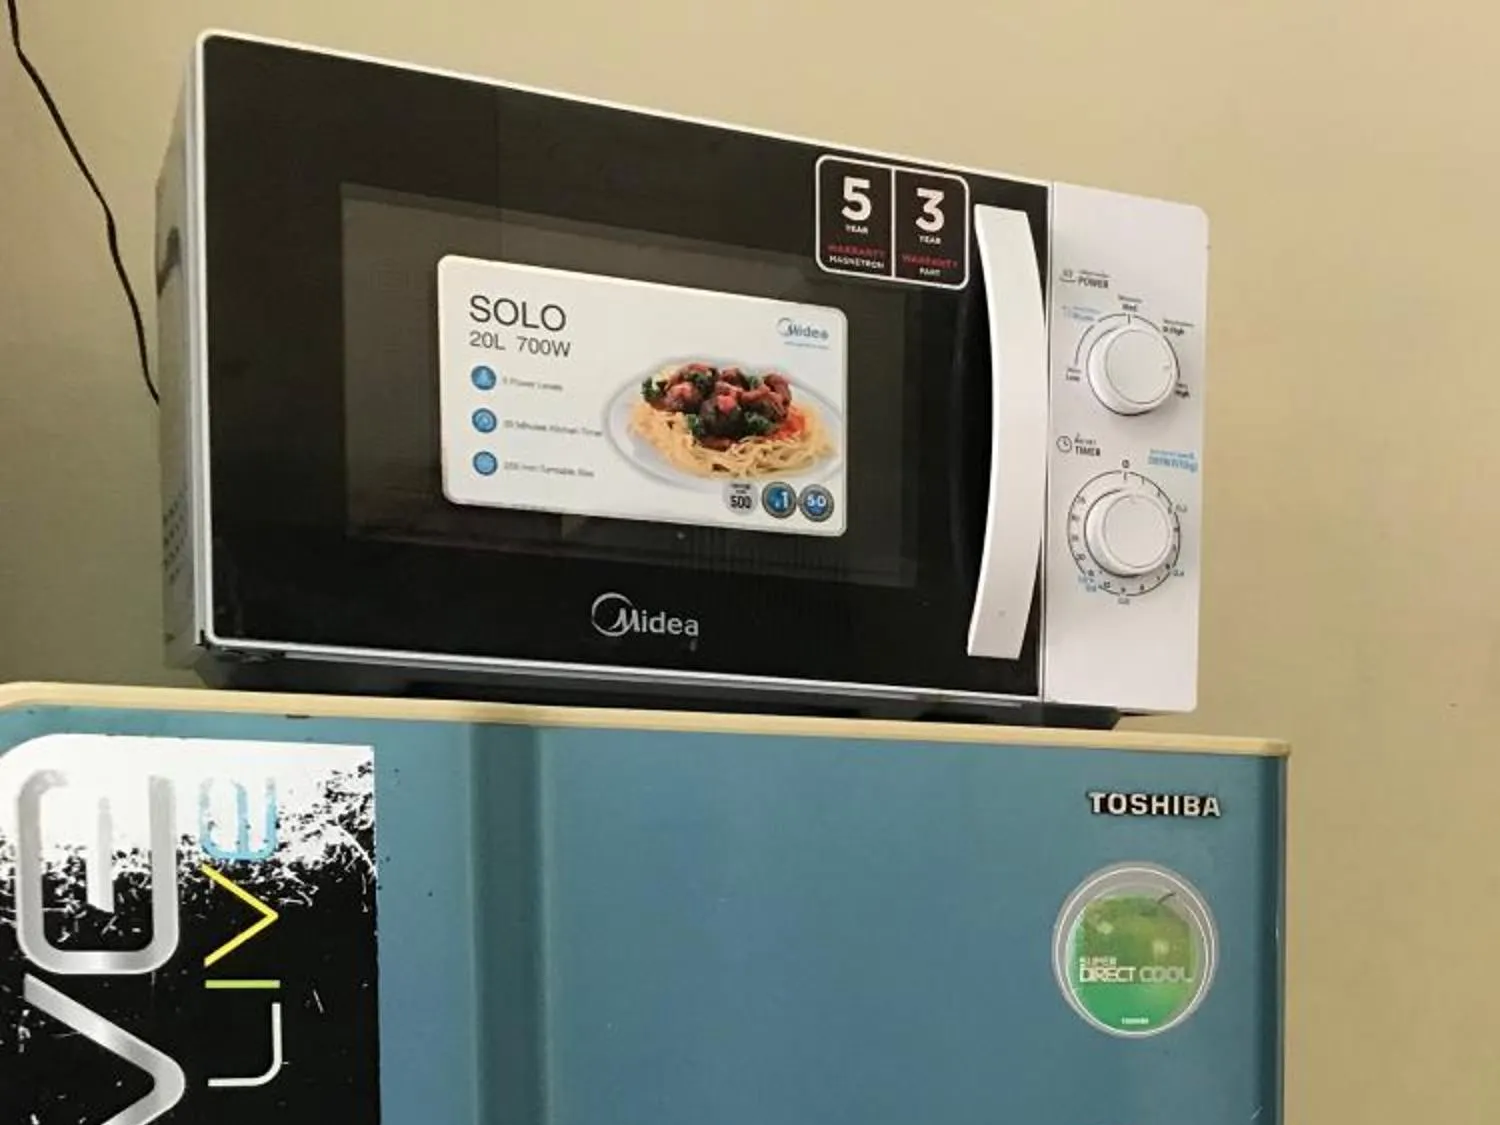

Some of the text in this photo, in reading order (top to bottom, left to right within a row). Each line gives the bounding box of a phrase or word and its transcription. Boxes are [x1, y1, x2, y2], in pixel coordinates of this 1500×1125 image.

[842, 175, 872, 221] 5
[915, 187, 945, 232] 3
[845, 225, 869, 235] YEAR
[918, 235, 942, 245] YEAR
[1078, 276, 1109, 289] POWER
[469, 294, 567, 332] SOLO
[469, 330, 572, 358] 20L 700W
[1075, 445, 1101, 457] TIMER
[591, 592, 700, 637] Midea
[1088, 791, 1222, 818] TOSHIBA
[200, 776, 283, 1088] LIVE
[1079, 966, 1195, 983] DIRECT COOL
